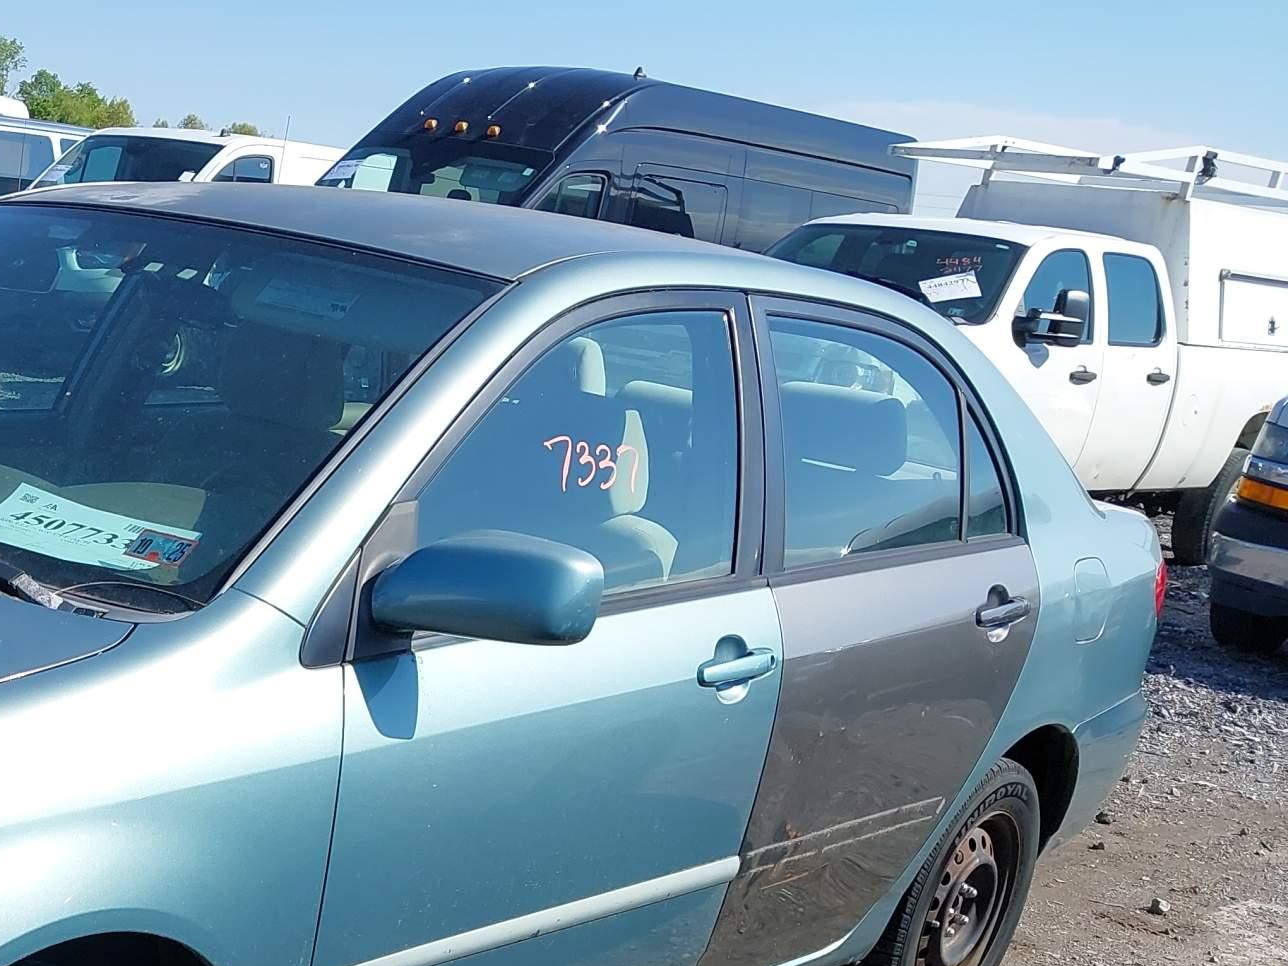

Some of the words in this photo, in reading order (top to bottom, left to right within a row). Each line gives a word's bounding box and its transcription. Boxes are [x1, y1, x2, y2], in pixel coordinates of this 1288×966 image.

[543, 435, 639, 493] 7337
[10, 511, 134, 550] 4507733
[133, 538, 153, 554] 10
[166, 542, 192, 562] 25
